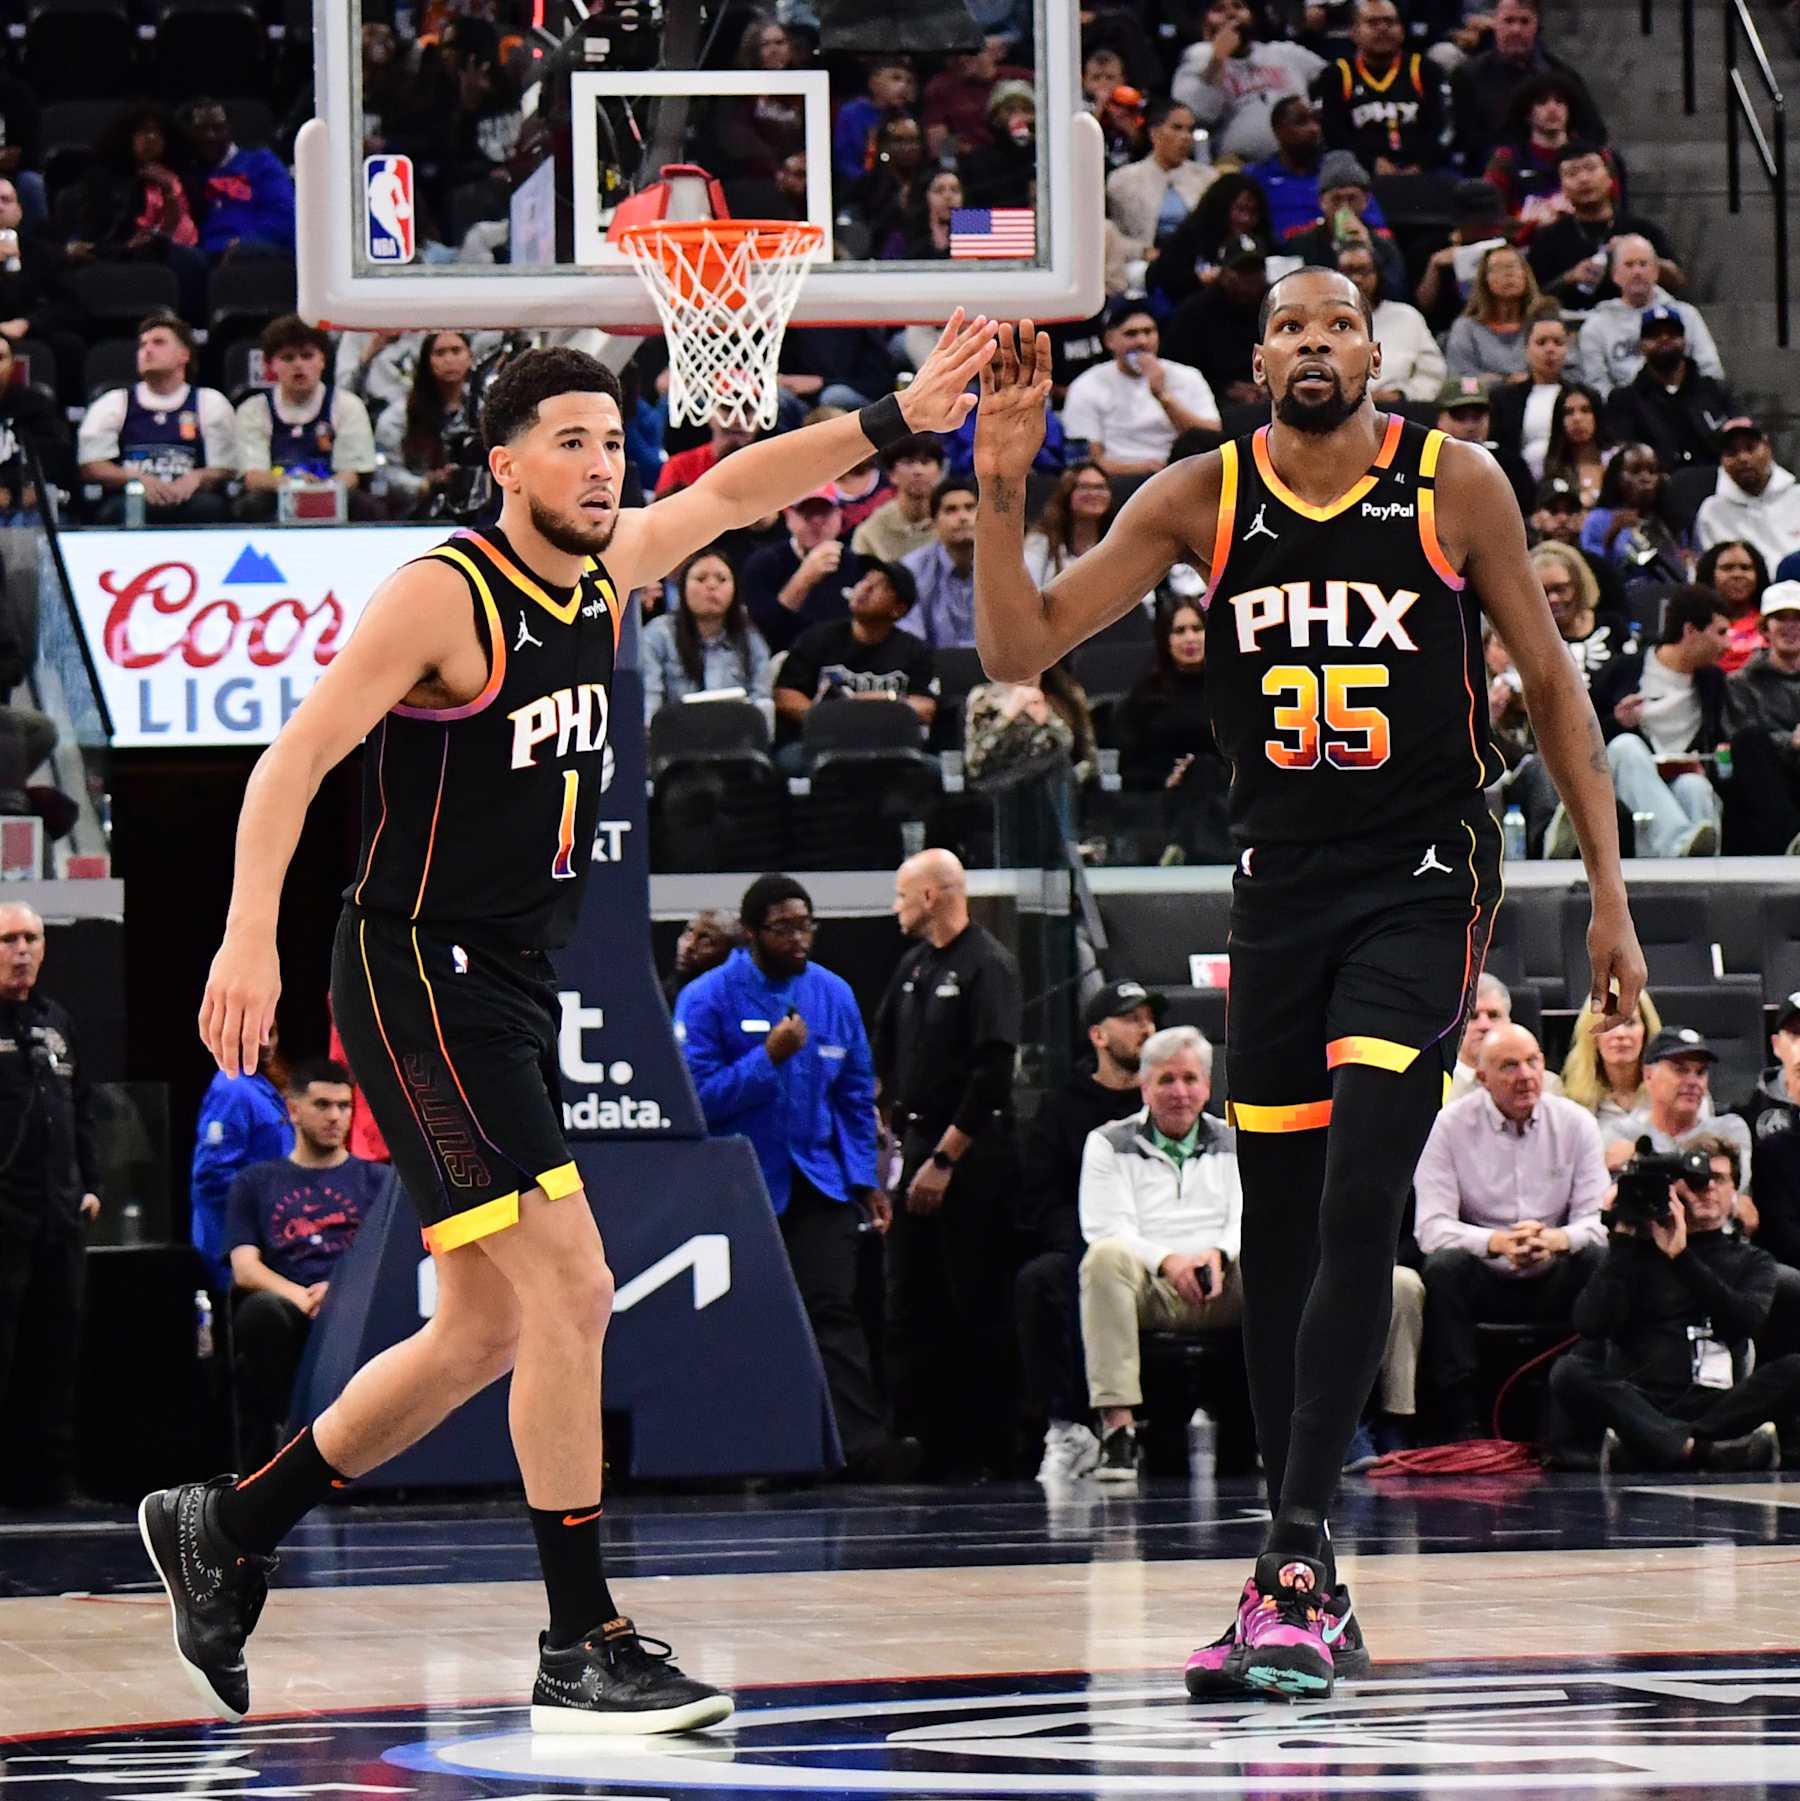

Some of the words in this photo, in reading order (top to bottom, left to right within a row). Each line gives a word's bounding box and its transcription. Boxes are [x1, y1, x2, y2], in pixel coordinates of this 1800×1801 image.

[1362, 502, 1414, 520] PayPal
[99, 561, 348, 669] Coor
[1228, 580, 1420, 653] PHX
[1262, 664, 1391, 770] 35
[551, 769, 577, 879] 1
